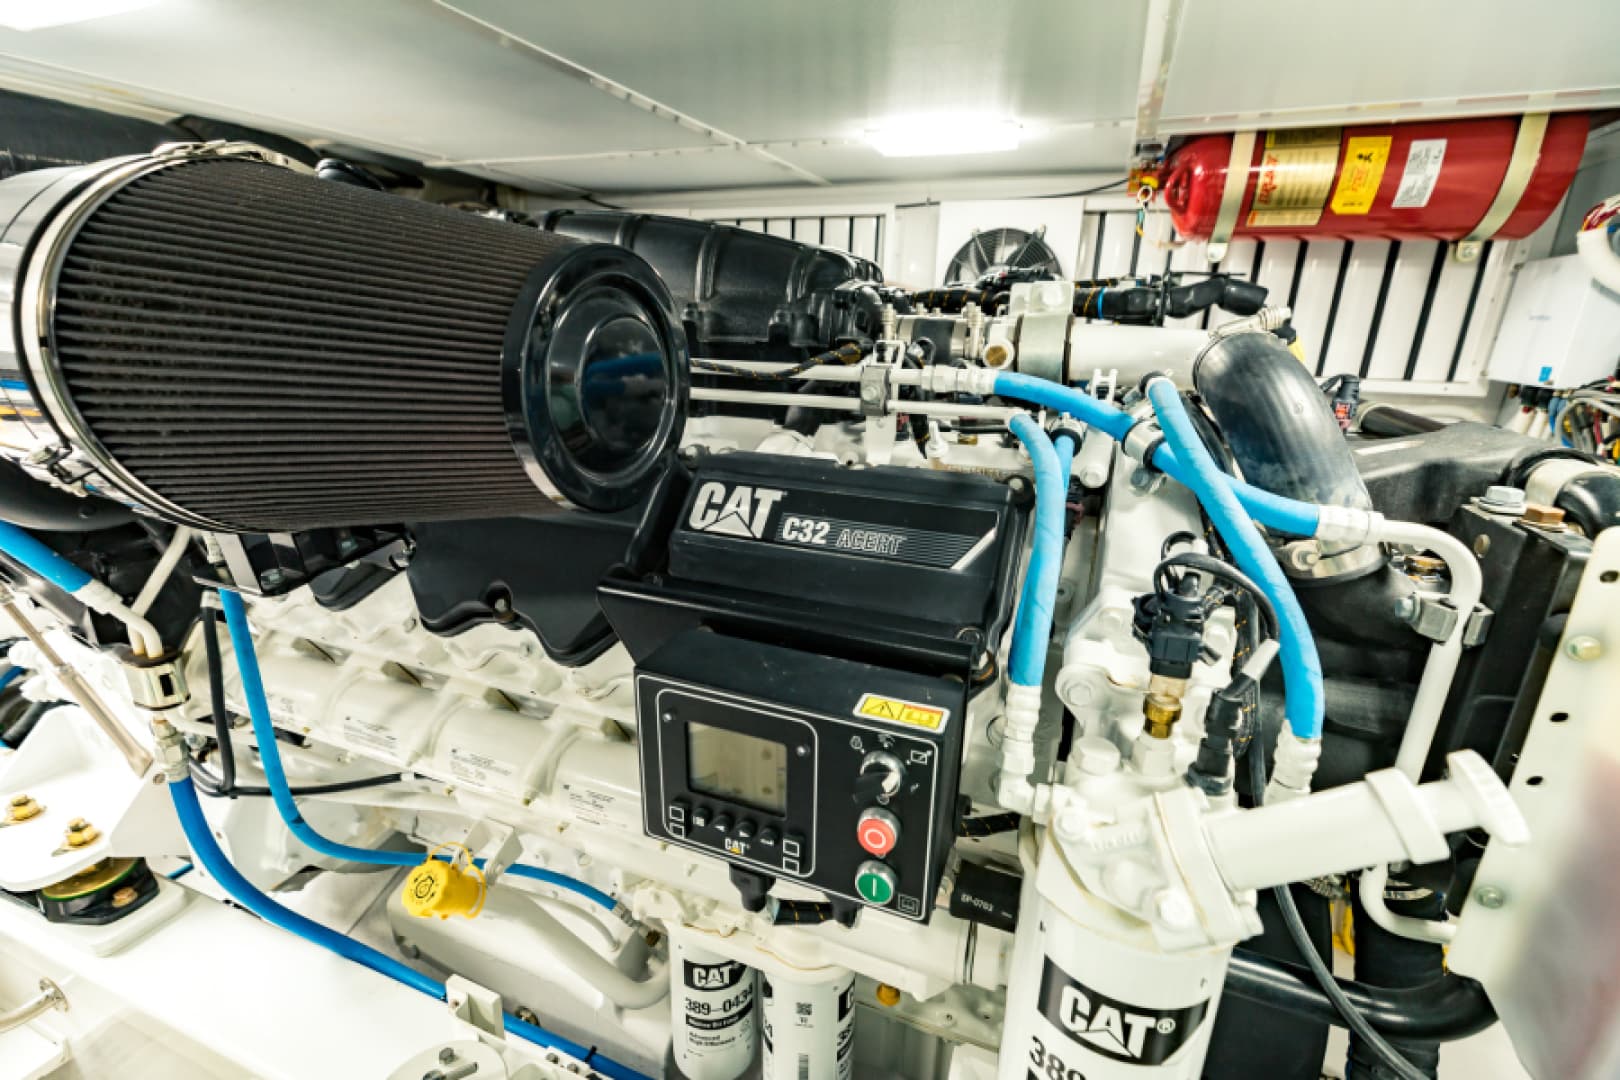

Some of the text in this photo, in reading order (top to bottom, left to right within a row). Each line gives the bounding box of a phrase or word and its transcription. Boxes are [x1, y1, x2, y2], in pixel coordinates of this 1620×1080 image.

[689, 481, 784, 538] CAT
[782, 517, 905, 555] C32 ACERT
[692, 965, 731, 987] CAT
